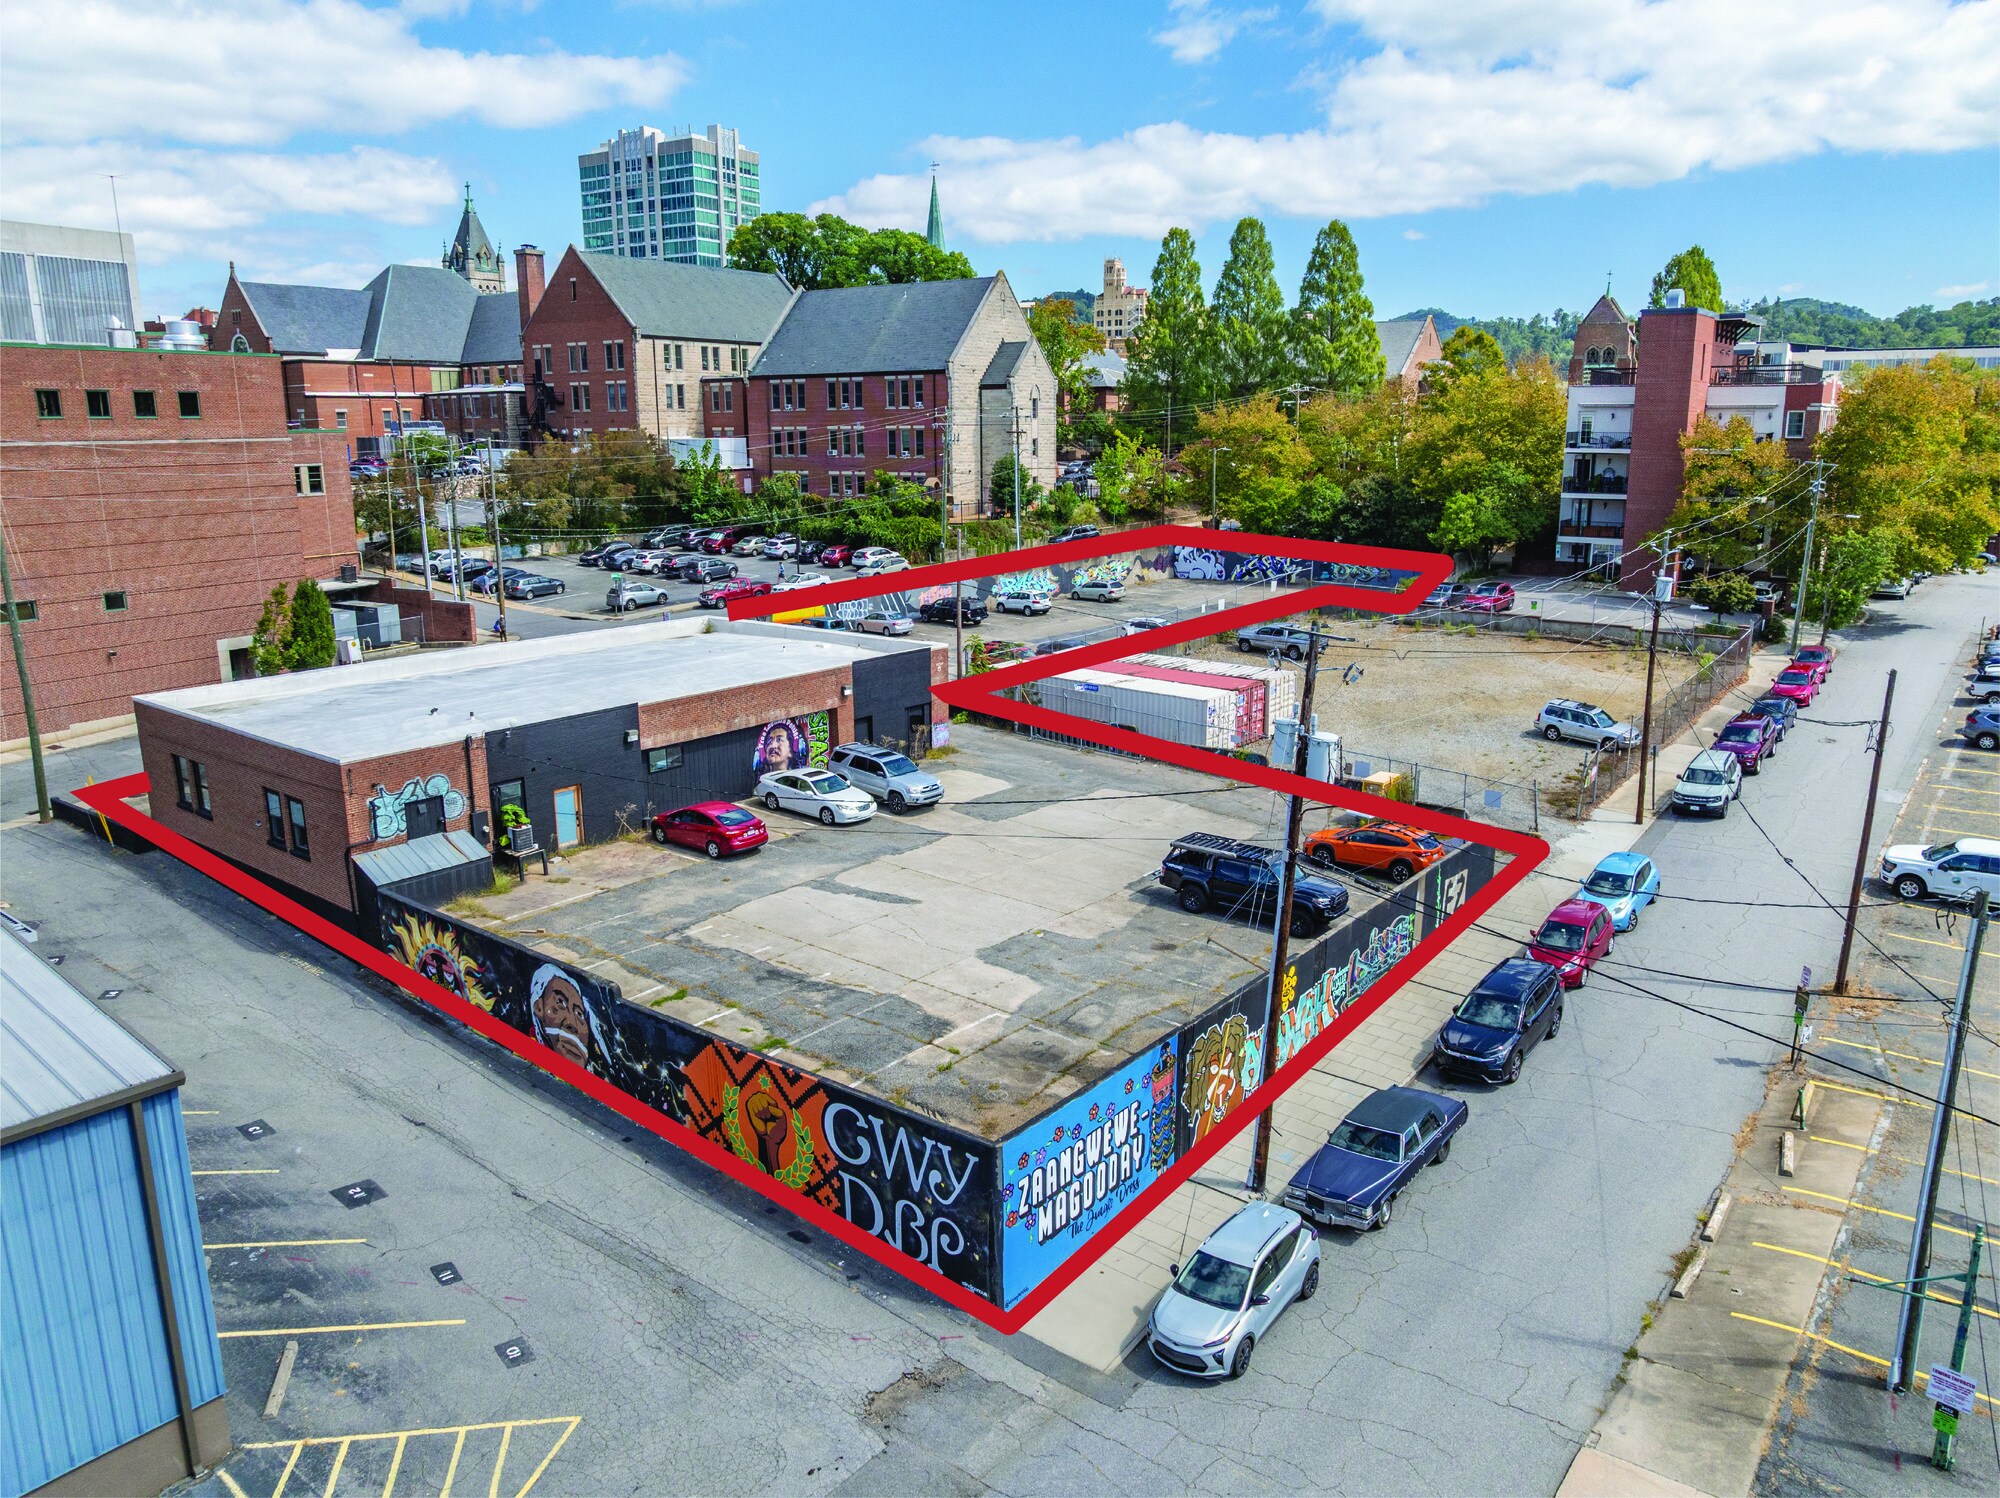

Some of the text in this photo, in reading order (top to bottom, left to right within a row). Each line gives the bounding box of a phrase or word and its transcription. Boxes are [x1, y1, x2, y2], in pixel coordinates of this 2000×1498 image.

[1018, 1100, 1149, 1218] ZAANGWEWE-
[1038, 1133, 1144, 1246] MAGOODAY
[349, 1187, 367, 1198] 12
[1067, 1219, 1084, 1239] The
